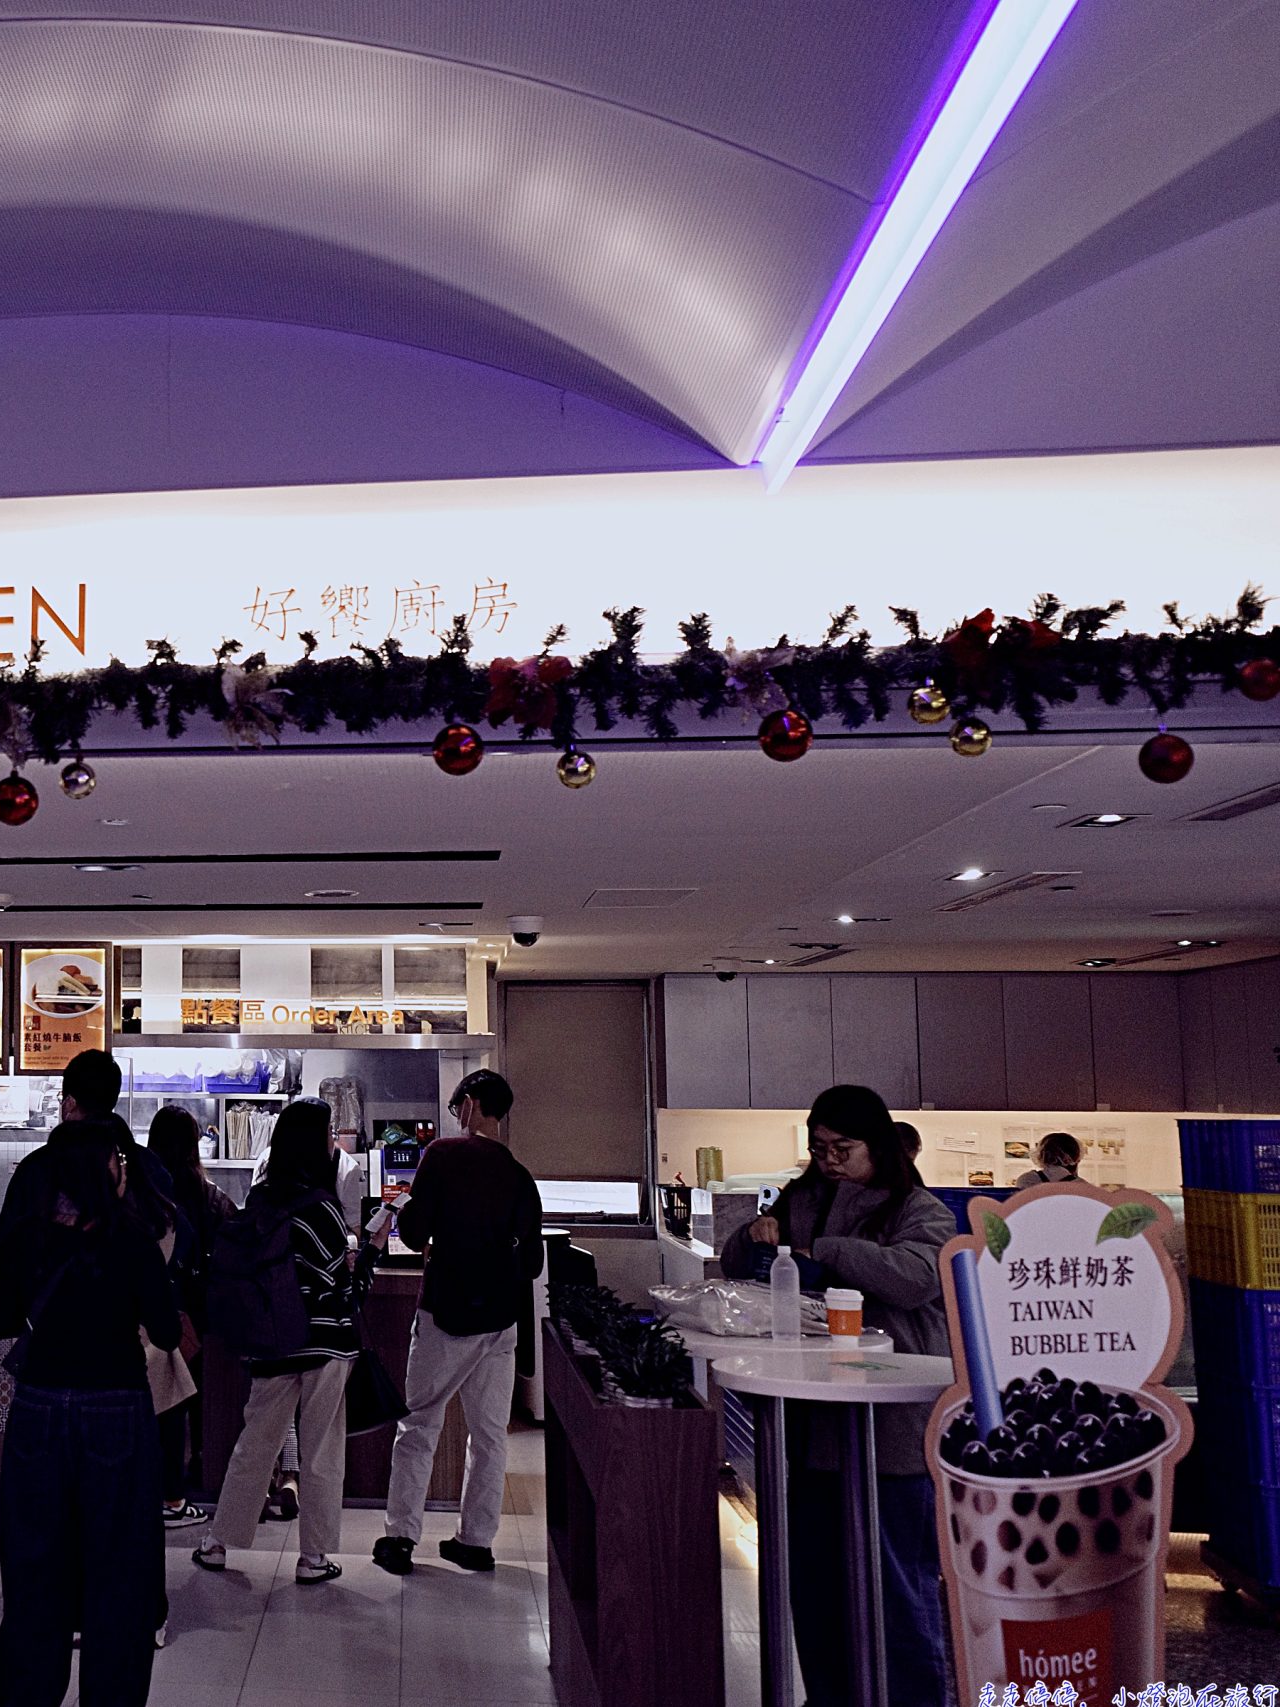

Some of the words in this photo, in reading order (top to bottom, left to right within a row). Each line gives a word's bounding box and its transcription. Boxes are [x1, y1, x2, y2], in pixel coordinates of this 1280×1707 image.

[243, 577, 518, 641] 好饗廚房
[180, 998, 266, 1025] 點餐區
[272, 1004, 337, 1025] Order
[346, 1004, 405, 1025] Area
[1007, 1256, 1135, 1290] 珍珠鮮奶茶
[1009, 1299, 1094, 1322] TAIWAN
[1011, 1332, 1088, 1356] BUBBLE
[1094, 1331, 1137, 1353] TEA
